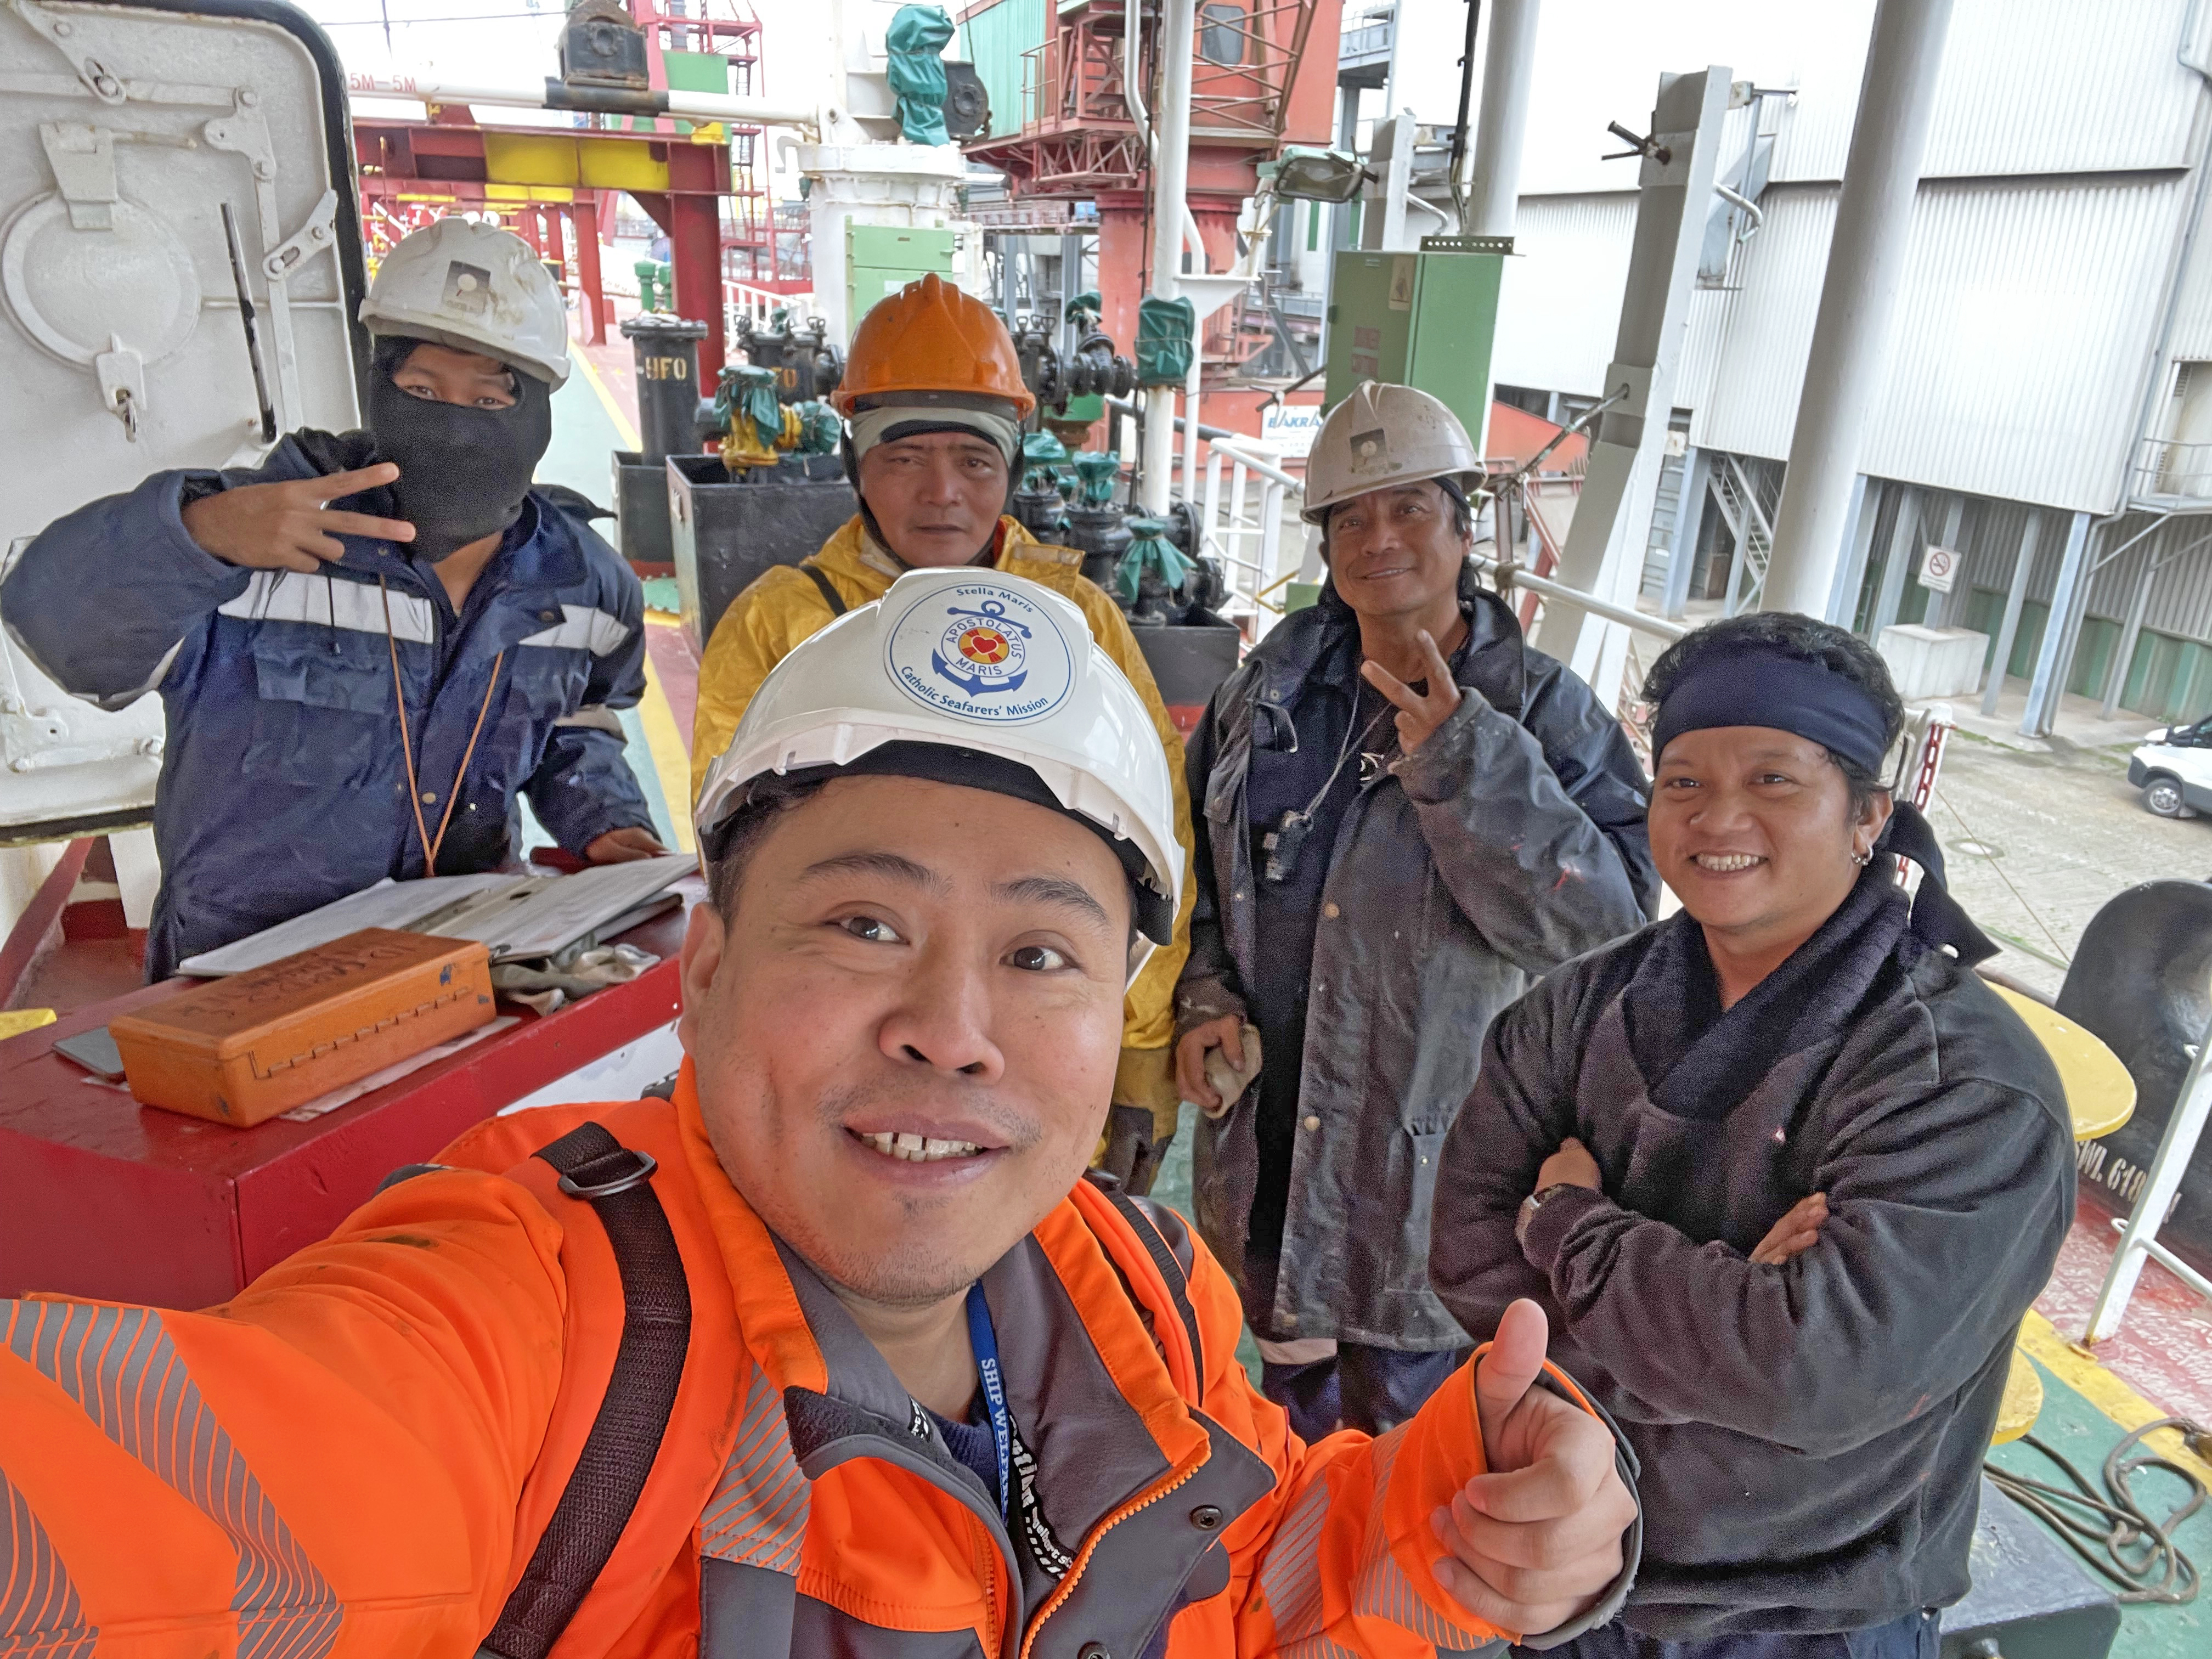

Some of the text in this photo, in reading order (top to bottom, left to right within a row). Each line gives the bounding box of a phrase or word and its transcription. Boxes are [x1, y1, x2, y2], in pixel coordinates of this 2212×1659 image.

[645, 357, 687, 380] HFO
[956, 587, 1033, 612] Stella Maris
[945, 618, 1022, 659] APOSTOLATUS
[956, 658, 1002, 675] MARIS
[901, 667, 1048, 715] Catholic Seafarers' Mission
[981, 1358, 1003, 1406] SHIP
